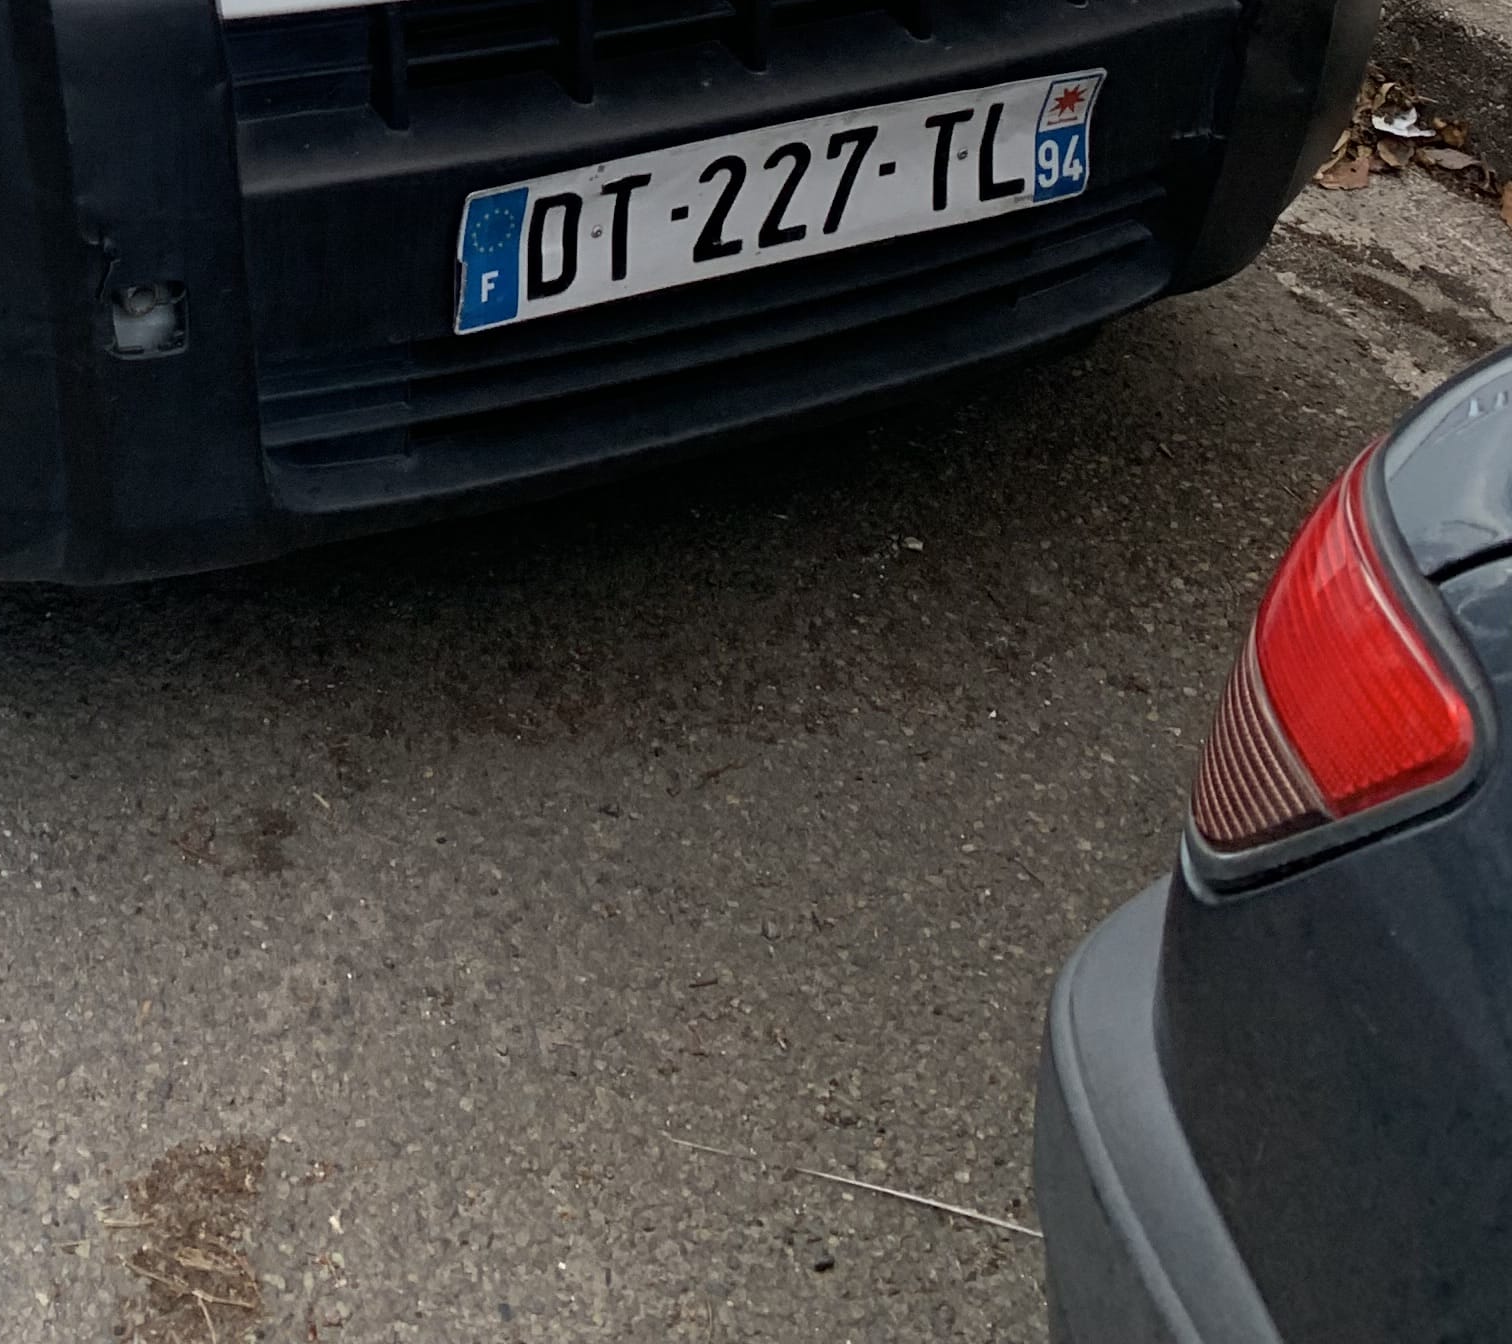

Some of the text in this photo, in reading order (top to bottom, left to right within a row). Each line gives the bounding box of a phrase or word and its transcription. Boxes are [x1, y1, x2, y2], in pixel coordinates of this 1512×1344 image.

[1037, 134, 1083, 188] 94
[526, 102, 1025, 302] DT-227-TL
[481, 270, 499, 303] F
